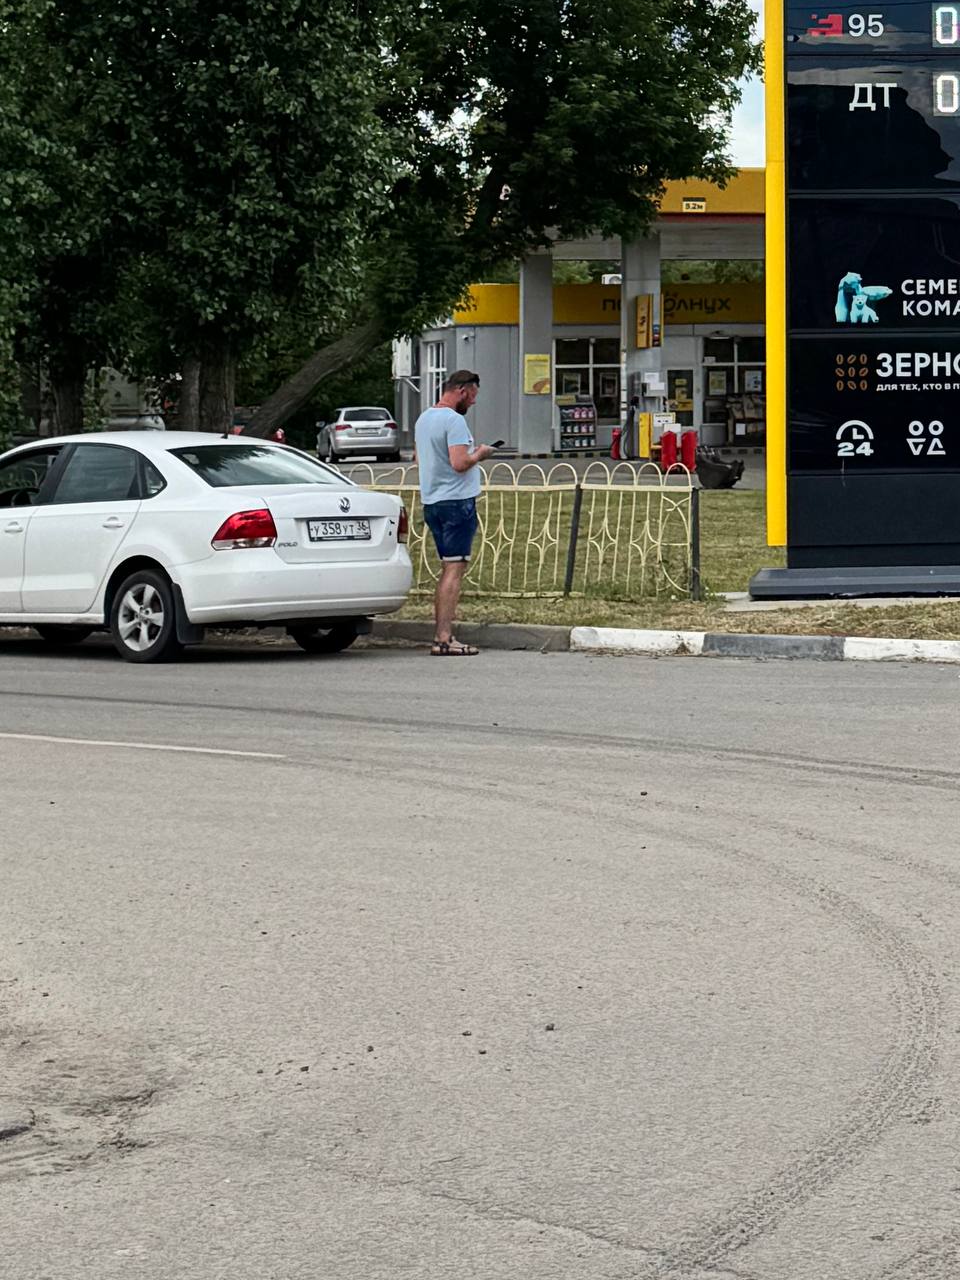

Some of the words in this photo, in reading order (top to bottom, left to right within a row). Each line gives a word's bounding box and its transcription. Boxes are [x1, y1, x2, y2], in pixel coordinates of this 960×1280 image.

[847, 13, 885, 37] 95
[849, 82, 898, 111] ДТ
[876, 383, 898, 392] ДЛЯ
[900, 383, 921, 392] ТЕХ,
[922, 383, 943, 391] КТО
[837, 441, 874, 457] 24
